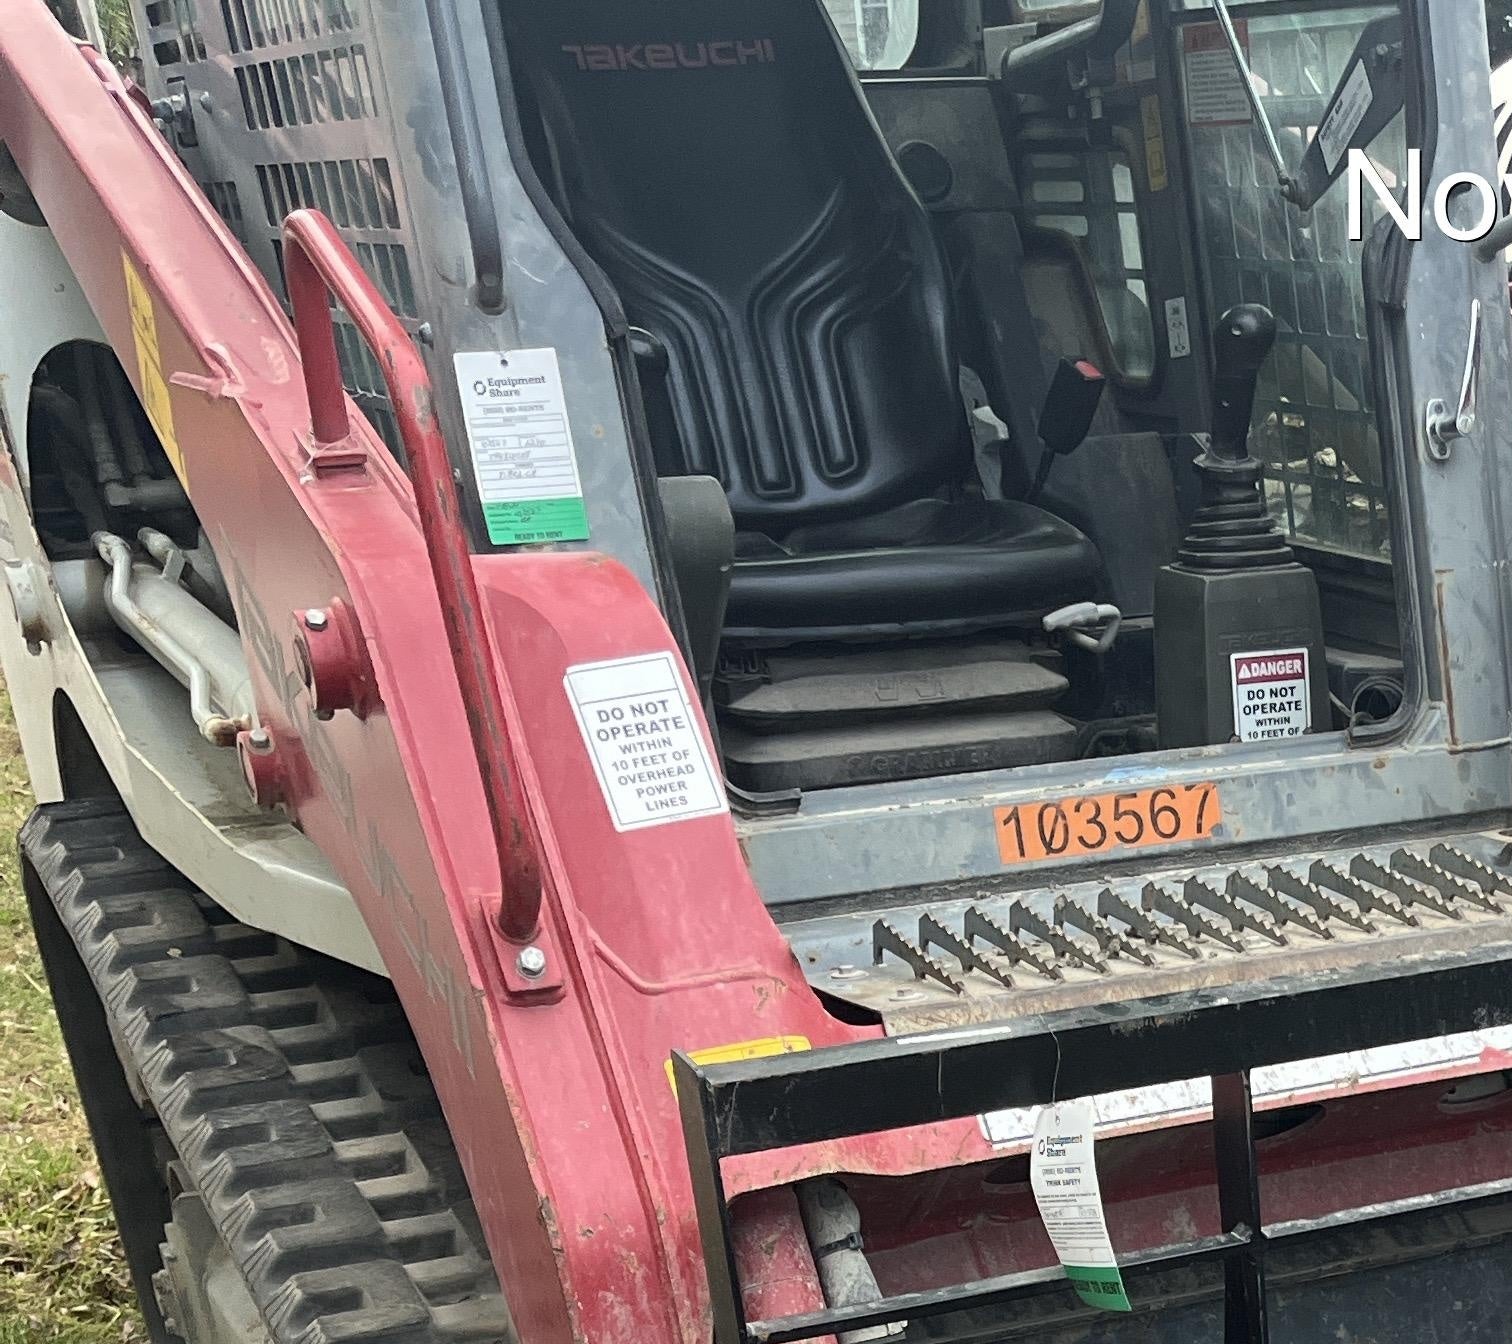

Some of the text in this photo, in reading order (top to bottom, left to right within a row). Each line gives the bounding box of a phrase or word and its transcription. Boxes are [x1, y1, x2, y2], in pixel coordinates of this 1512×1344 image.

[487, 375, 547, 388] Equipment
[489, 388, 521, 398] Share
[1251, 659, 1303, 678] DANGER
[1247, 686, 1297, 701] DO NOT
[596, 699, 670, 723] DO NOT
[1243, 700, 1303, 716] OPERATE
[597, 715, 686, 742] OPERATE
[1255, 716, 1291, 727] WITHIN
[1248, 727, 1300, 740] 10 FEET OF
[618, 736, 673, 755] WITHIN
[611, 749, 690, 772] 10 FEET OF
[617, 763, 696, 786] OVERHEAD
[636, 780, 688, 798] POWER
[645, 795, 688, 812] LINES
[1003, 783, 1217, 858] 103567
